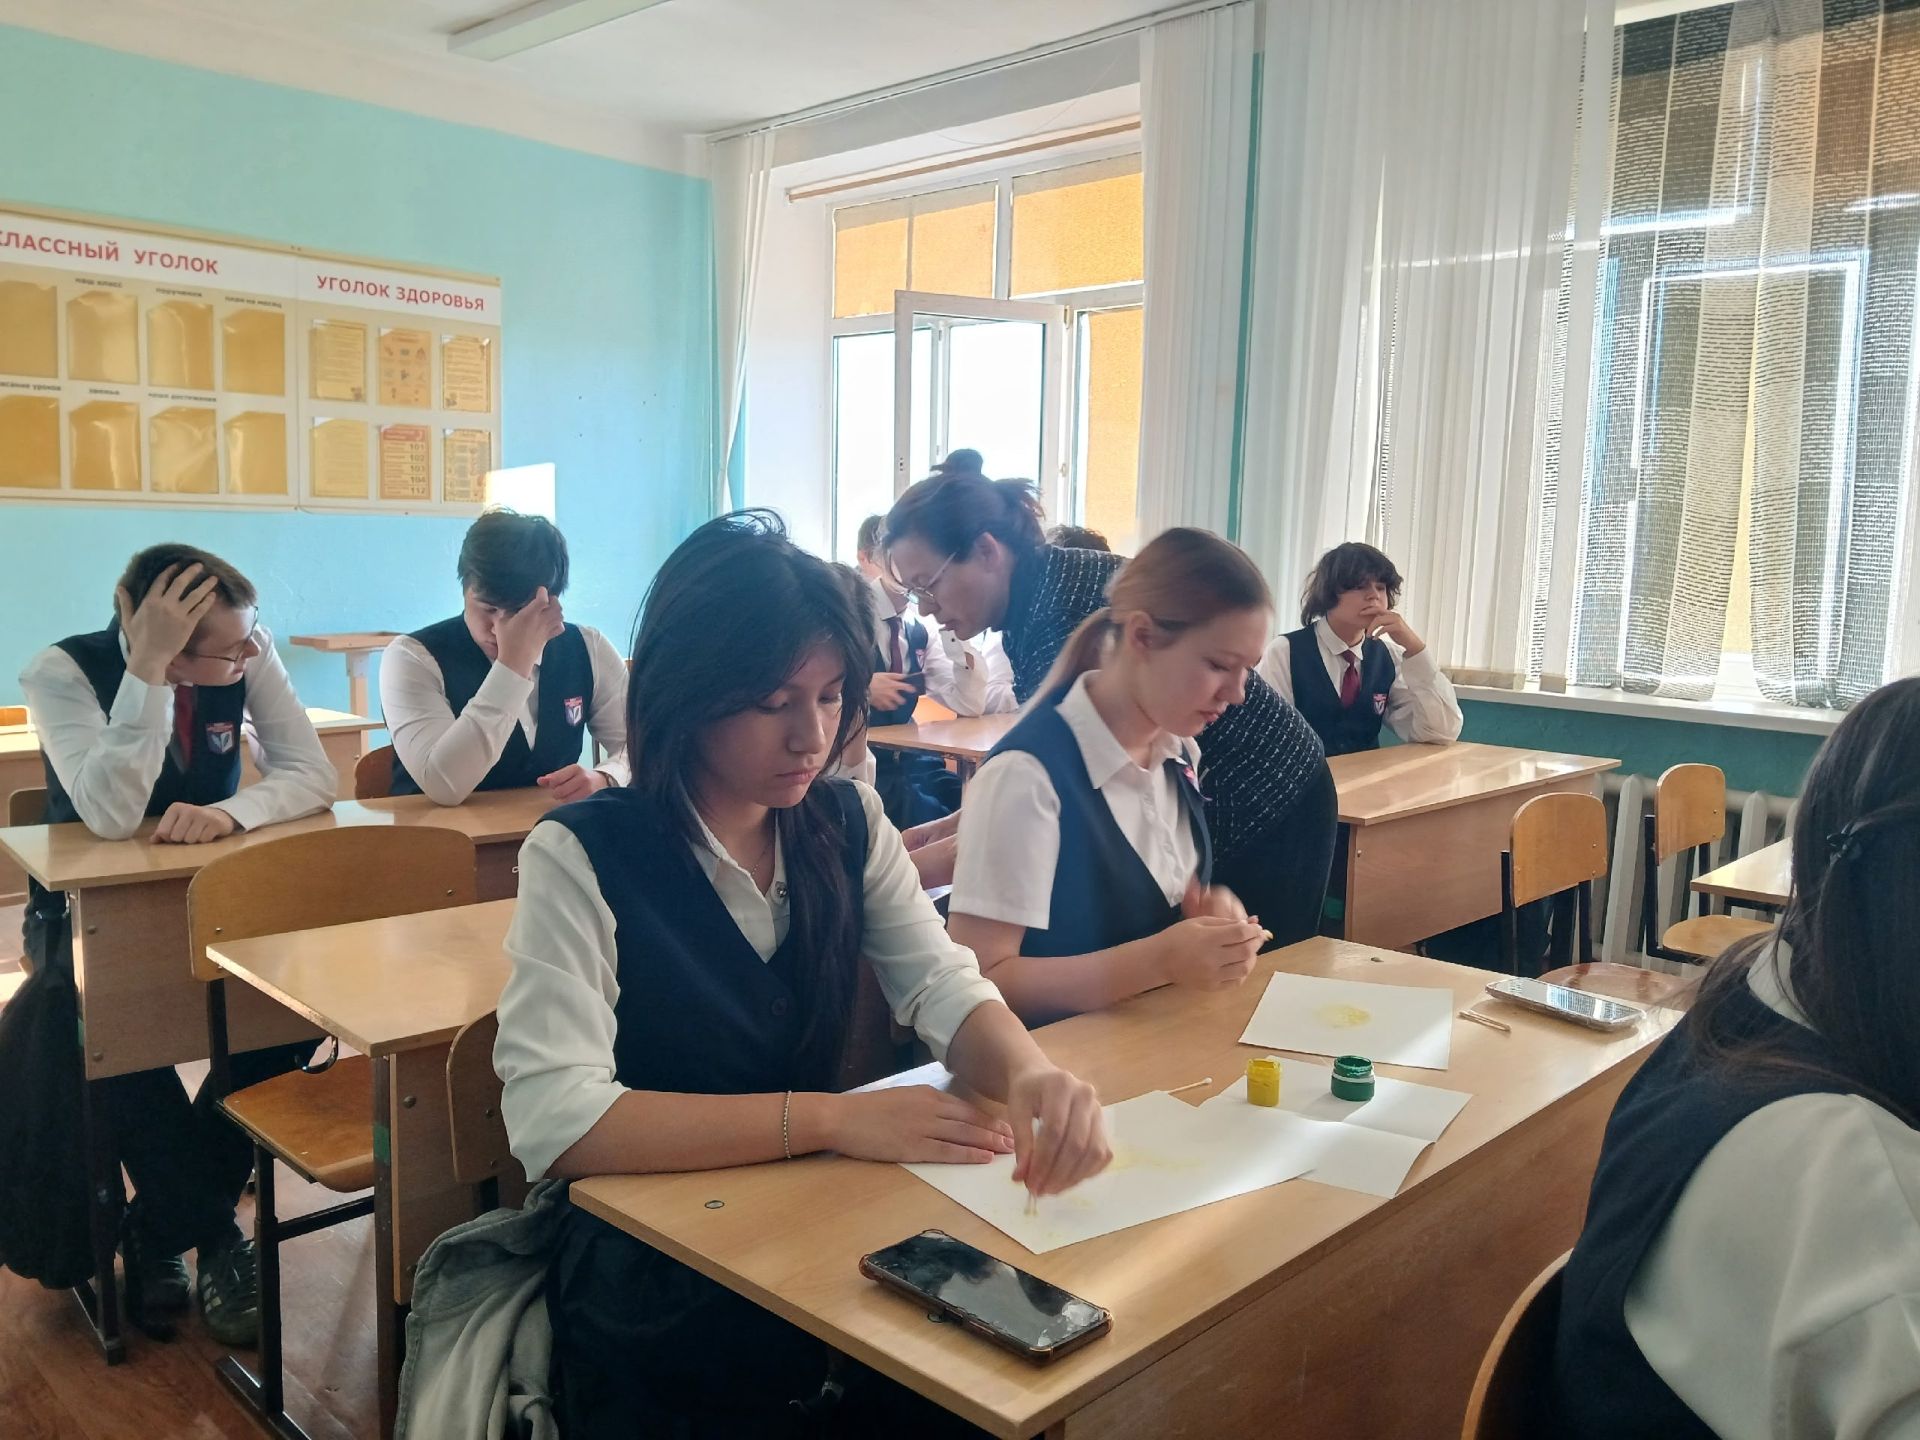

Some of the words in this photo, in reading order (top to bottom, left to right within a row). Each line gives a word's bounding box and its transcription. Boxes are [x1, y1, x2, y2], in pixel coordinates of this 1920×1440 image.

[0, 229, 119, 262] ЛАССНЫЙ
[133, 249, 219, 275] УГОЛОК
[317, 275, 390, 298] УГОЛОК
[396, 287, 484, 310] ЗДОРОВЬЯ
